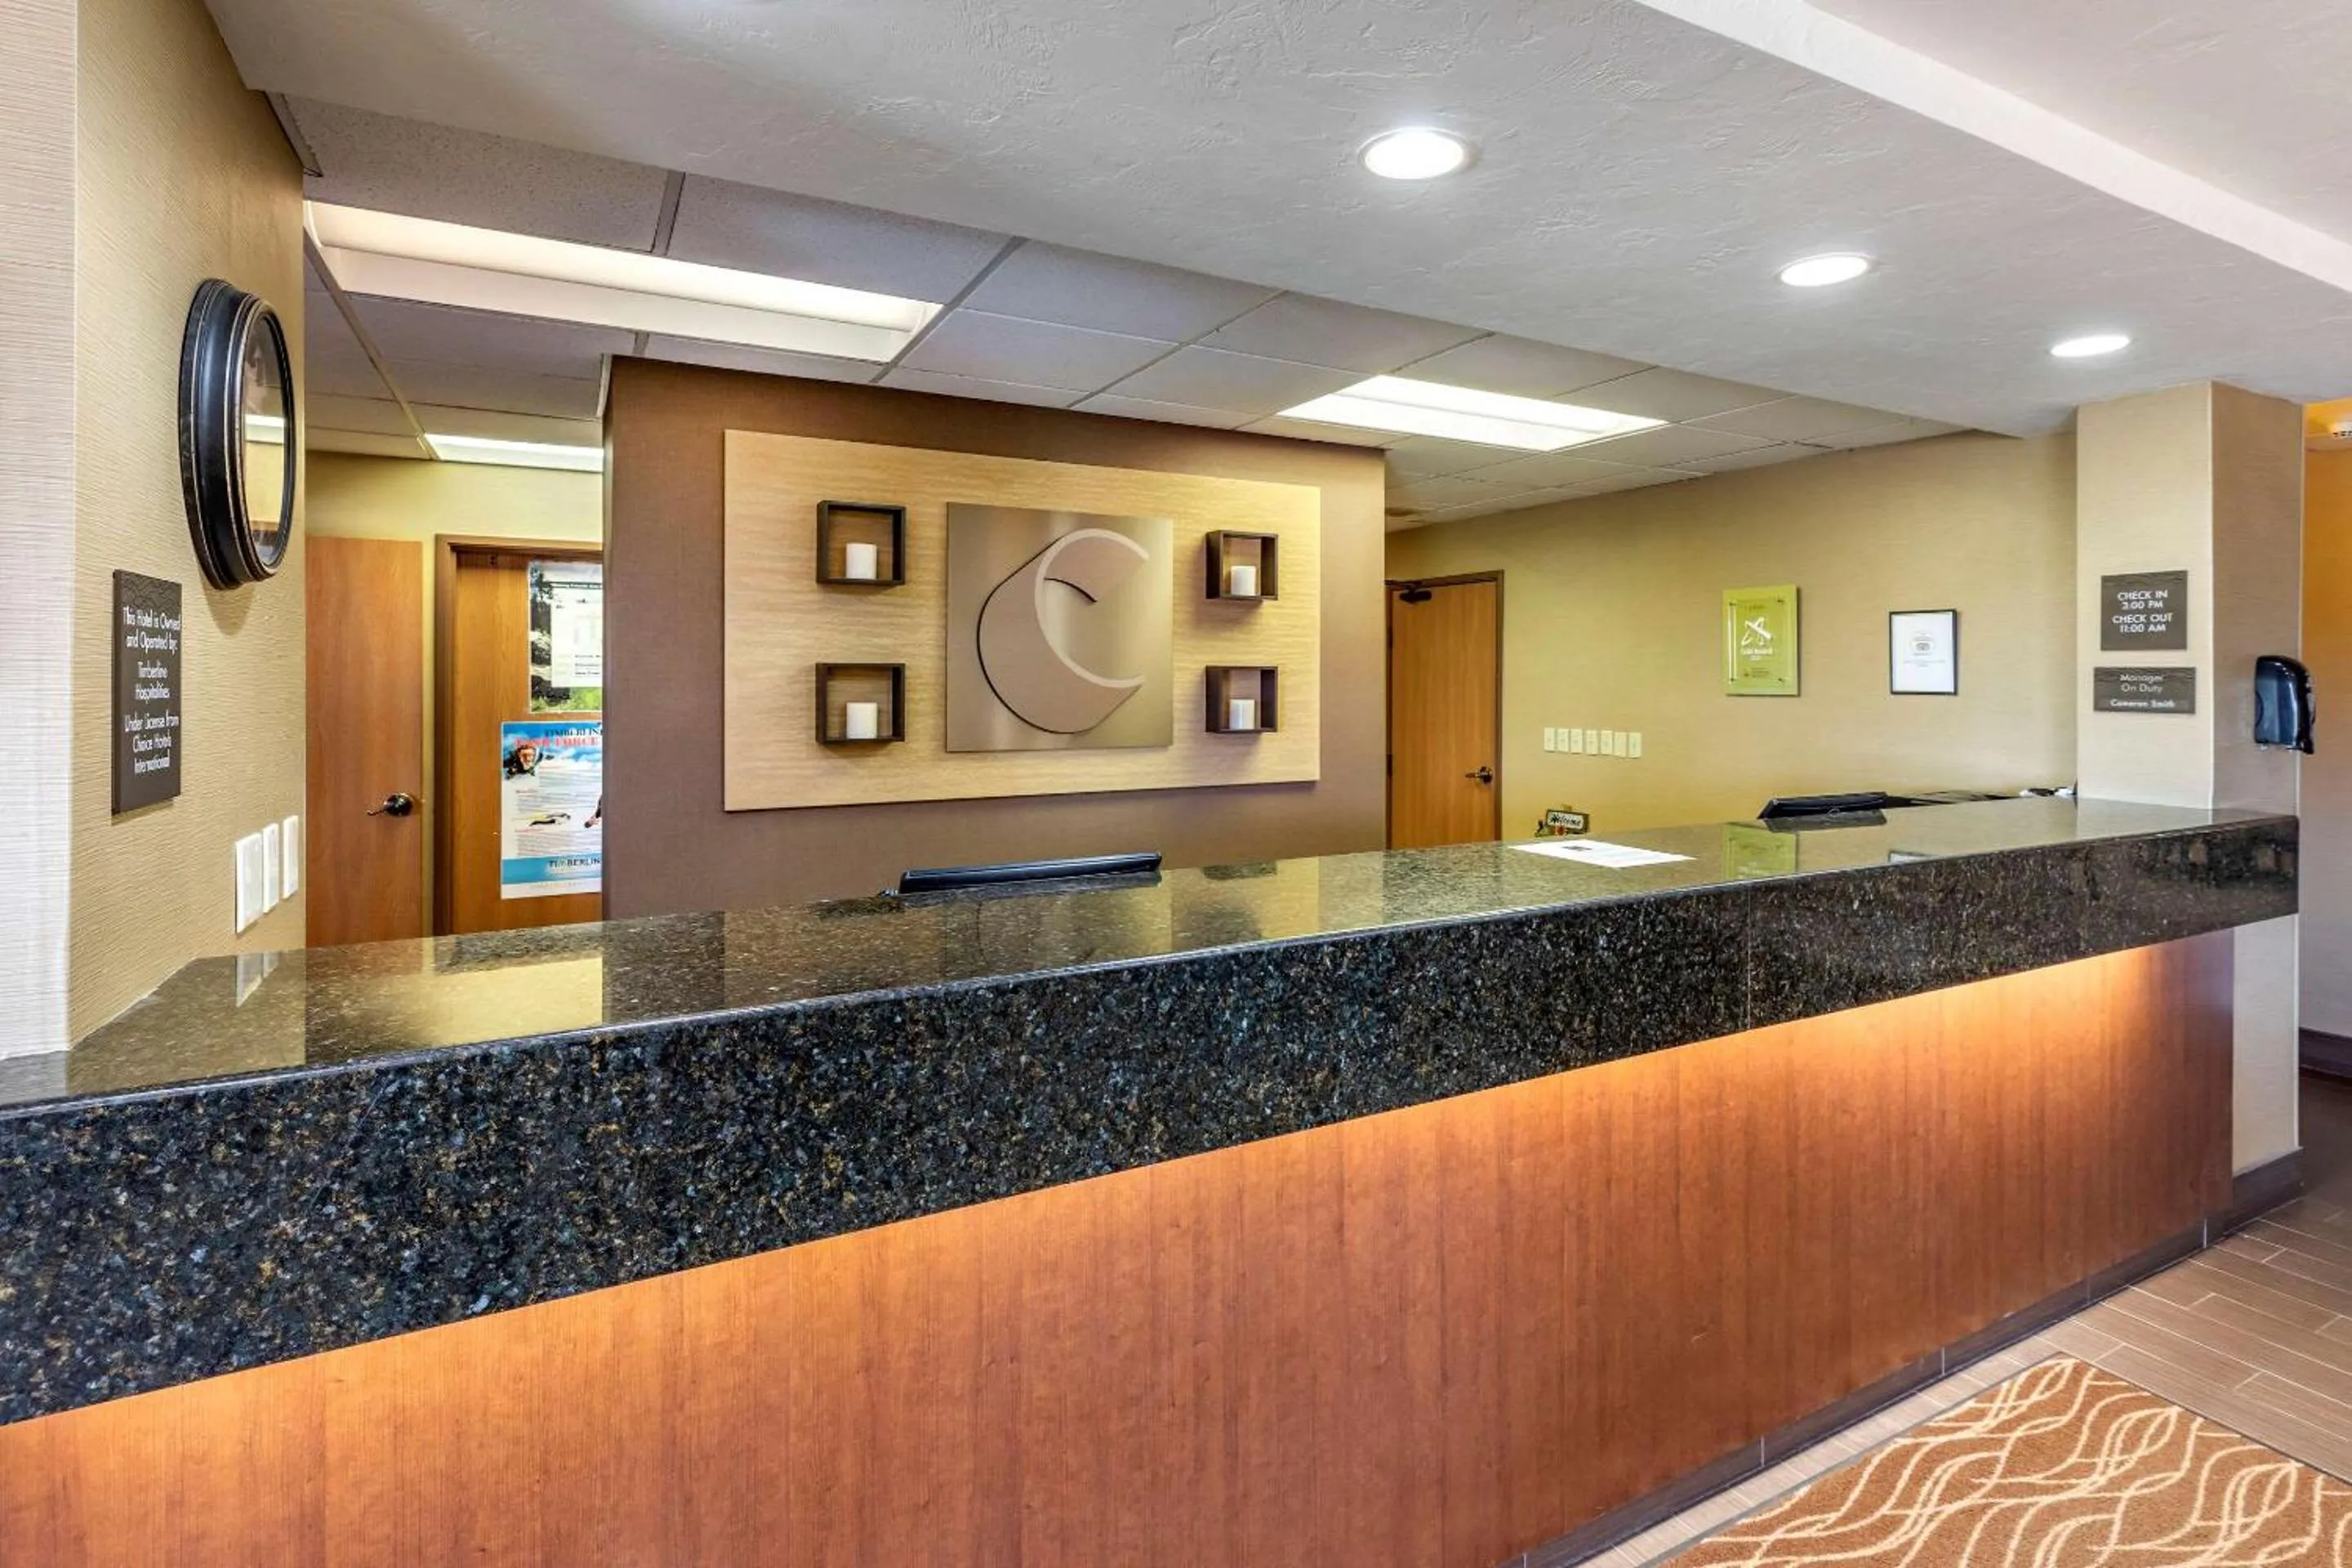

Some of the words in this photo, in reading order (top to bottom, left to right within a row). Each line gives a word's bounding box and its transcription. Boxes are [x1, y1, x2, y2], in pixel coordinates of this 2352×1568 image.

[2116, 590, 2154, 601] CHECK
[2155, 589, 2169, 599] IN
[2148, 599, 2164, 609] PM
[122, 605, 136, 626] This
[154, 612, 159, 628] is
[160, 612, 181, 630] Owned
[2112, 614, 2148, 624] CHECK
[2149, 612, 2174, 623] OUT
[2119, 623, 2145, 633] 11:00
[2148, 623, 2167, 633] AM
[127, 628, 139, 648] and
[140, 631, 168, 654] Operated
[137, 660, 168, 679] Timberline
[2120, 673, 2164, 684] Manager
[2121, 683, 2136, 693] On
[2139, 683, 2163, 694] Duty
[125, 711, 143, 733] Under
[145, 713, 165, 730] License
[133, 733, 153, 753] Choice
[154, 729, 172, 749] Hotels
[134, 749, 171, 775] International
[1548, 813, 1582, 826] Welcome
